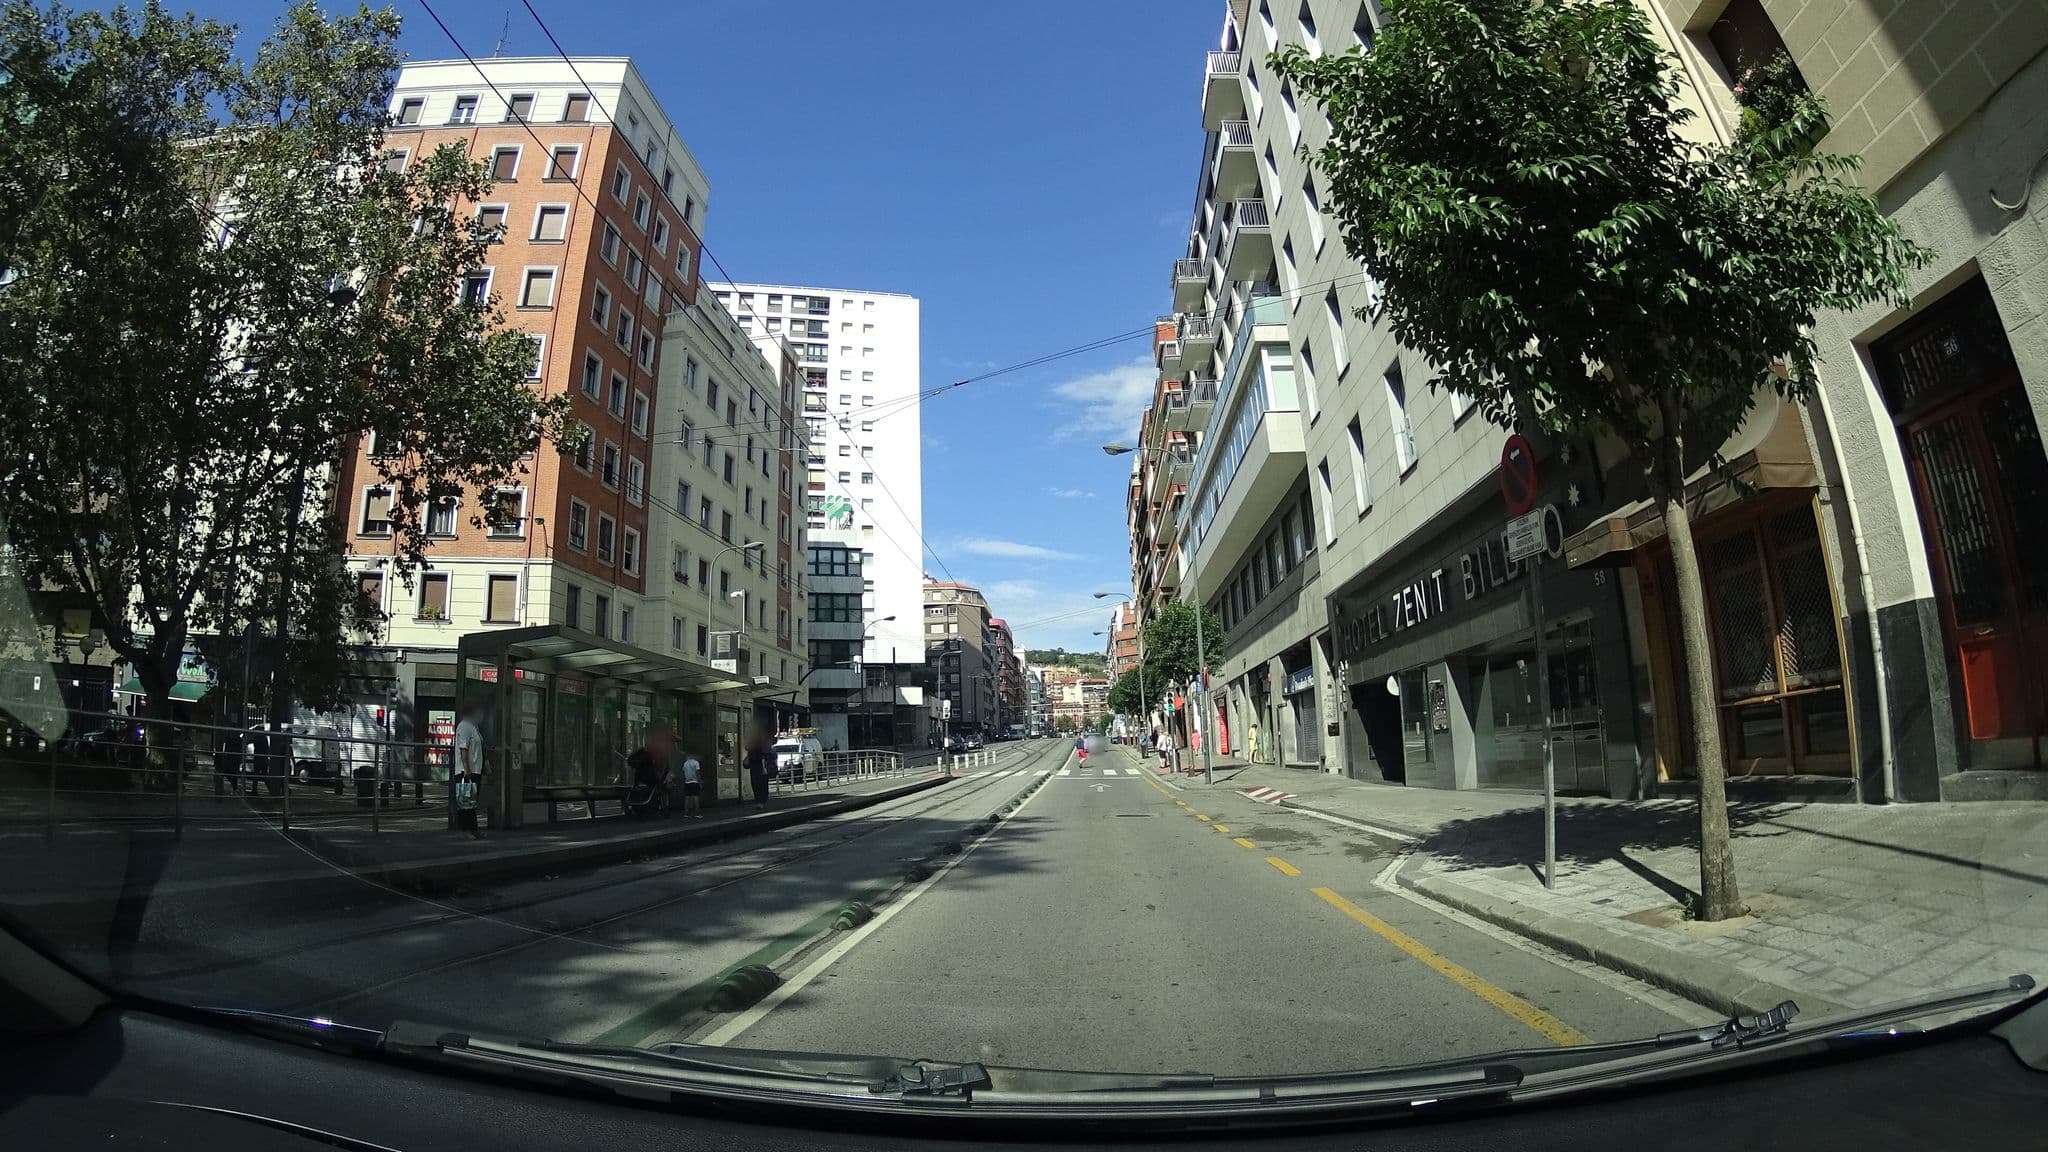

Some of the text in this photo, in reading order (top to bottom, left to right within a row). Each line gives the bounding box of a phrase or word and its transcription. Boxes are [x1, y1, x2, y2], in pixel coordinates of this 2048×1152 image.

[1343, 503, 1565, 656] HOTEL ZENIT BILBO
[1594, 569, 1606, 586] 58
